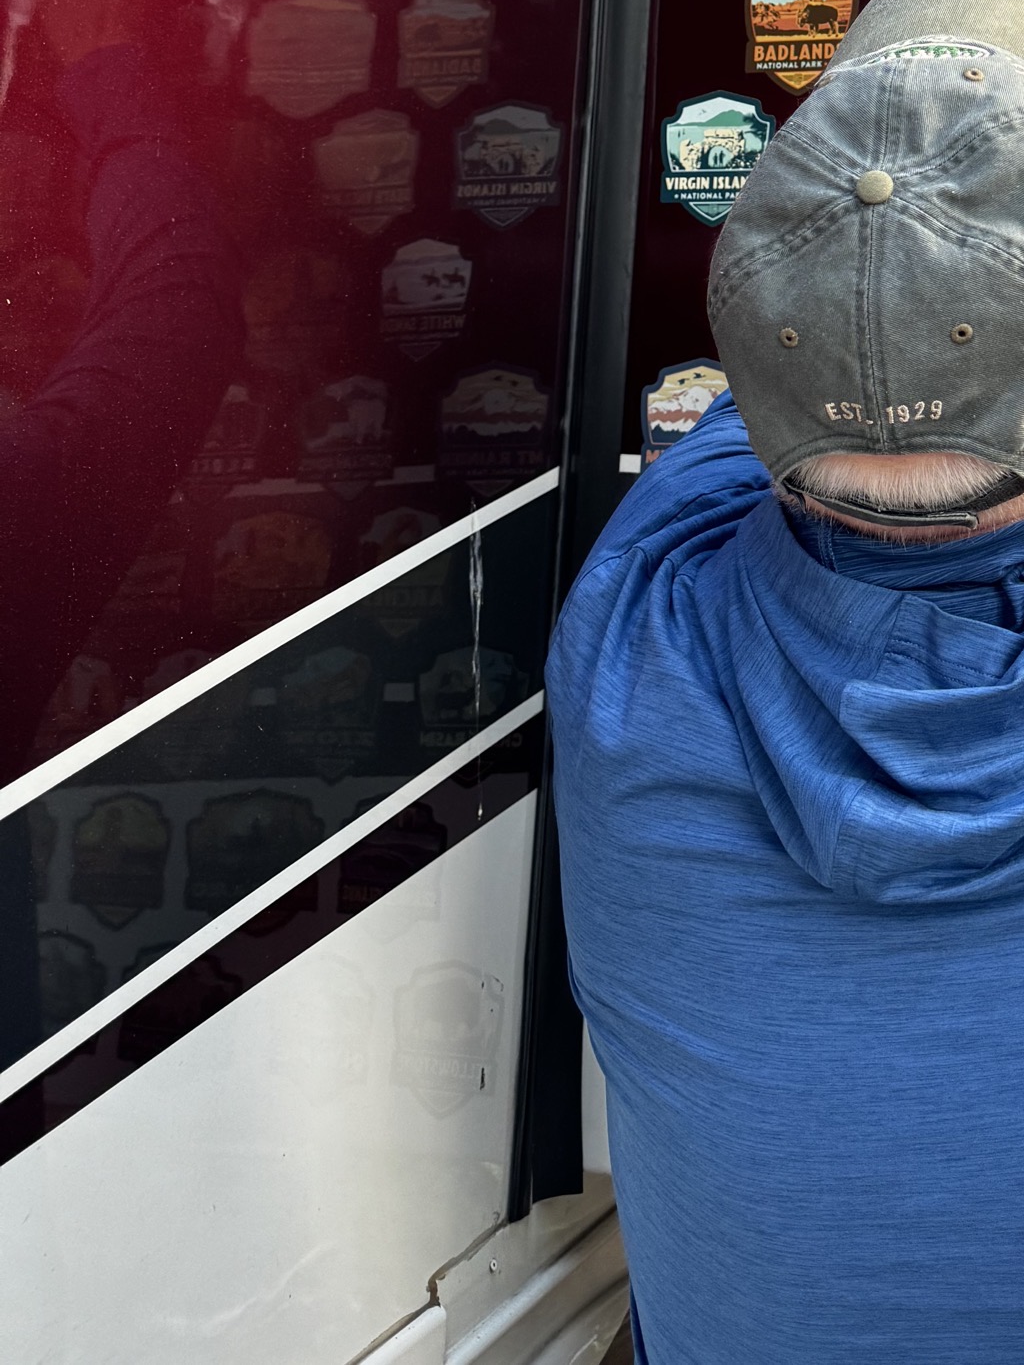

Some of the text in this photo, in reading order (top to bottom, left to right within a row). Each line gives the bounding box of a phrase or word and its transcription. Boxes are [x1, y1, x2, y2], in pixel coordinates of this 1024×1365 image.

[753, 43, 840, 62] BADLAND
[756, 61, 798, 70] NATIONAL
[665, 175, 749, 190] VIRGIN ISLAN
[680, 192, 722, 200] NATIONAL
[824, 400, 943, 425] EST. 1929
